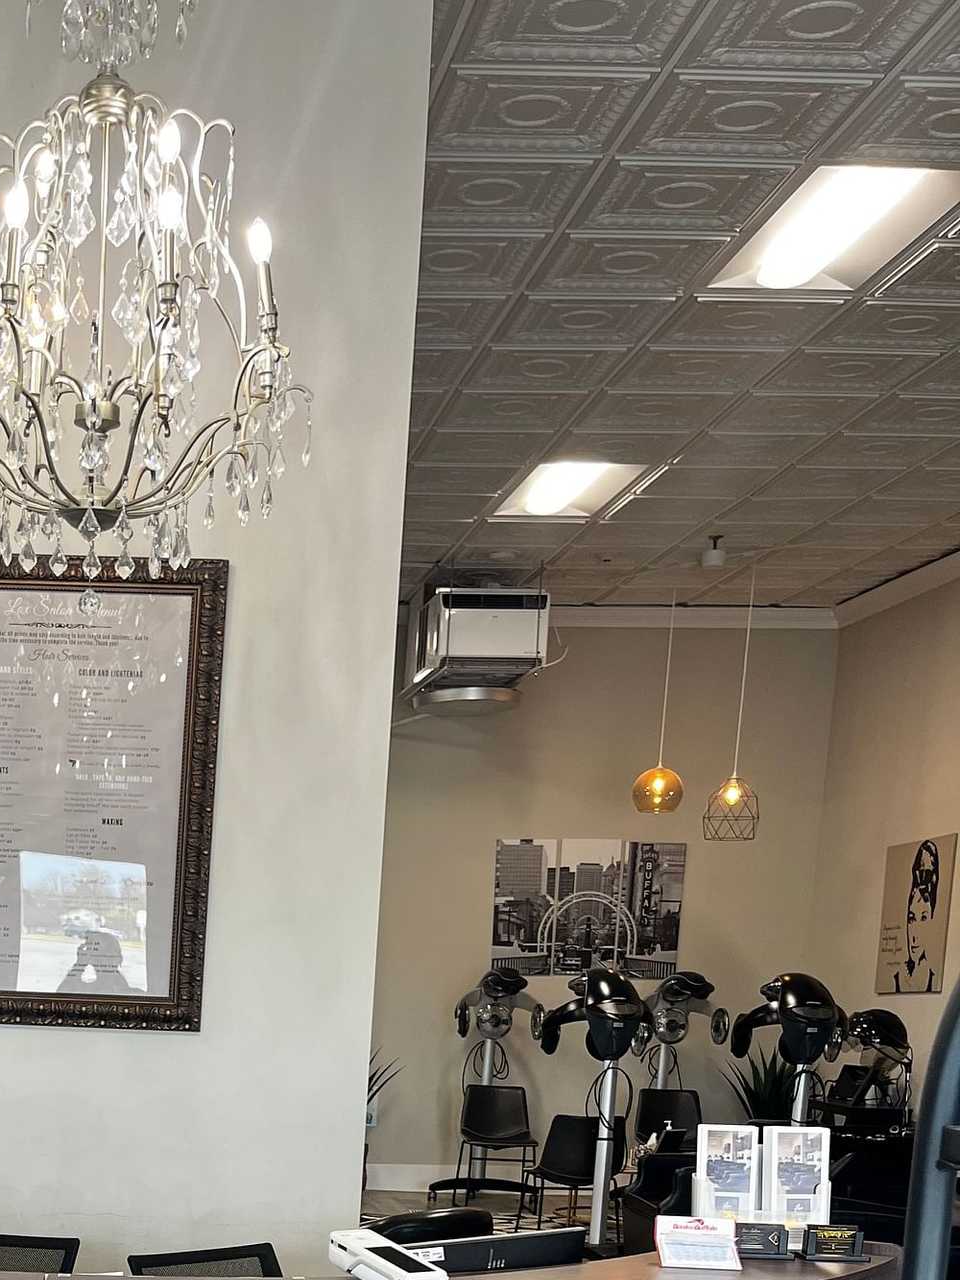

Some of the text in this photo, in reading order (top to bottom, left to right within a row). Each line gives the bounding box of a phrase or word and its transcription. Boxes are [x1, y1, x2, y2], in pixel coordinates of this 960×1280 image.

[27, 649, 56, 661] Hair
[97, 669, 110, 677] AND
[641, 862, 653, 925] BUFFALO
